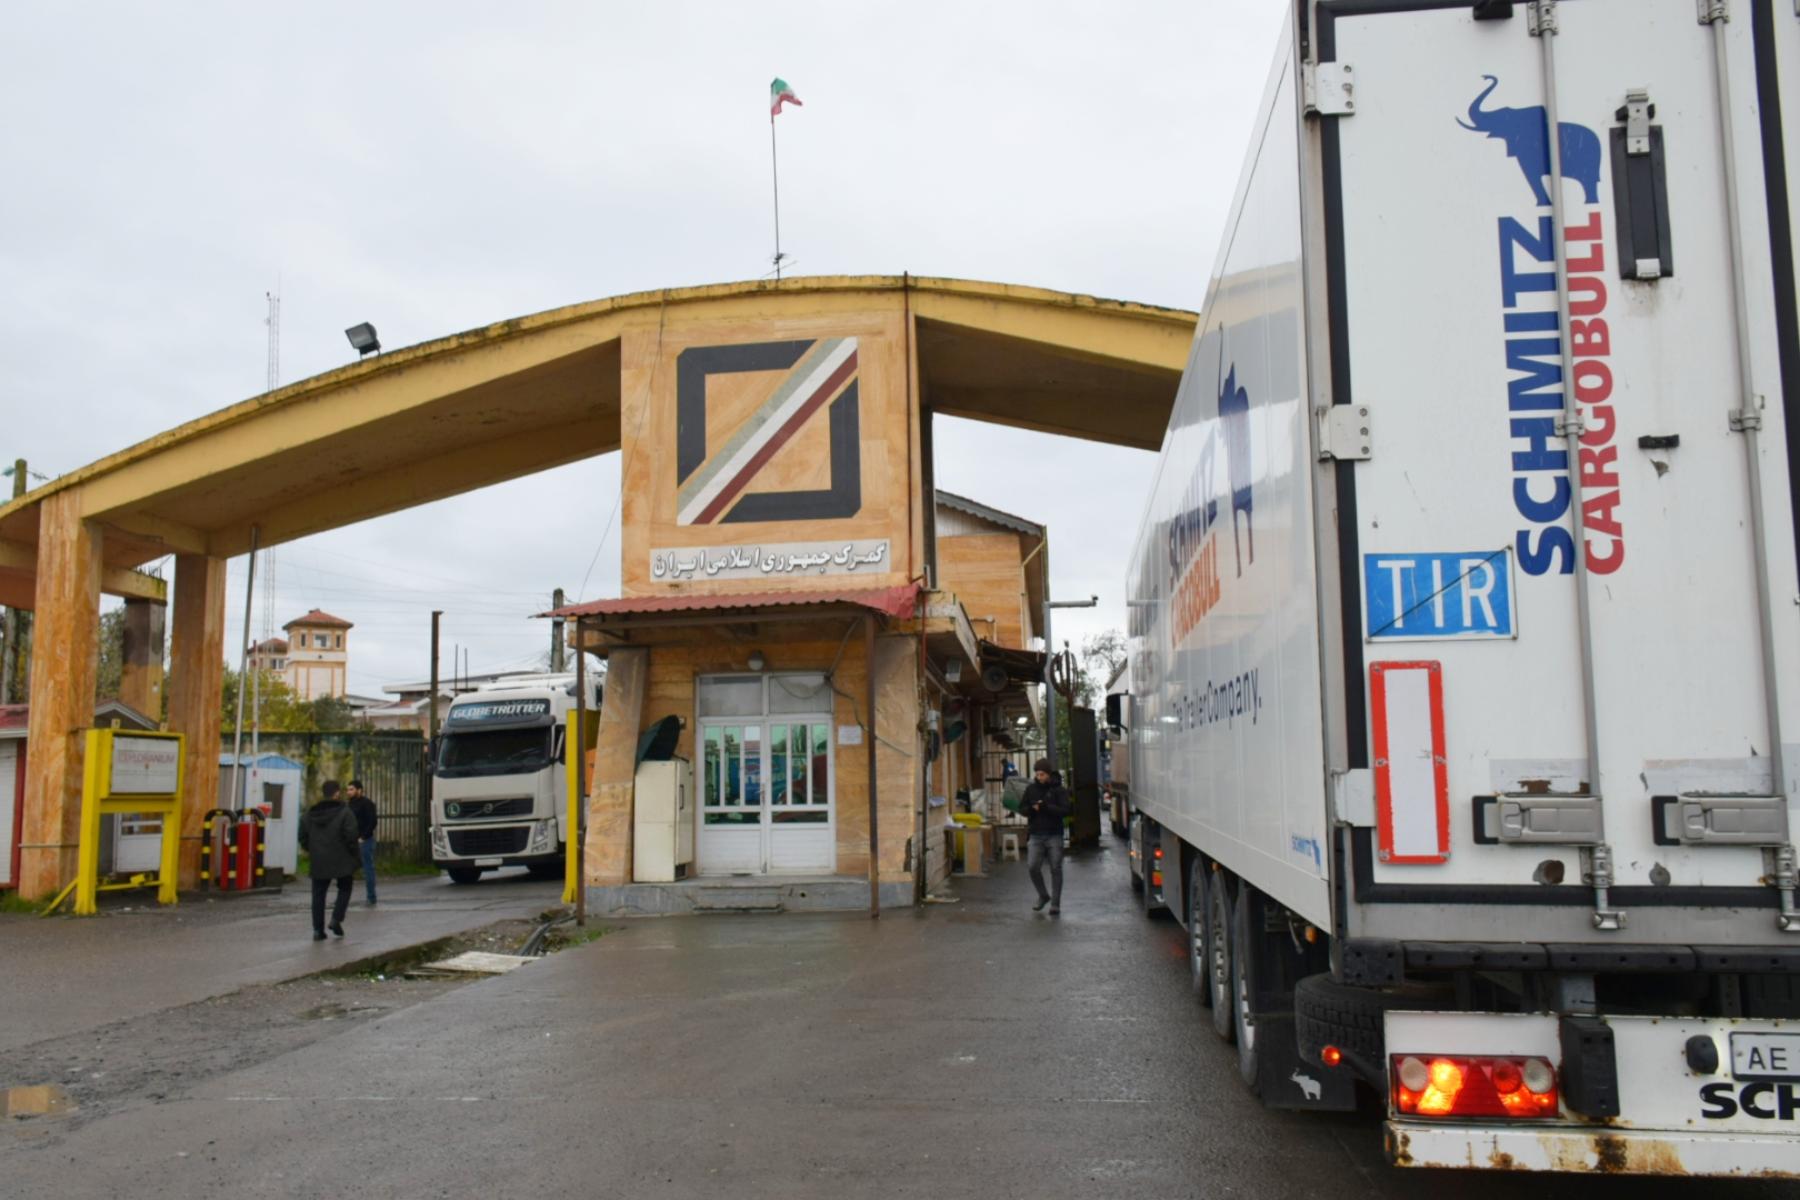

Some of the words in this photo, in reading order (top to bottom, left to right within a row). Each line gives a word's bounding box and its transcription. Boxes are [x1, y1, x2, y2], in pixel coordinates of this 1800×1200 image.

[1498, 216, 1576, 577] SCHMITZ
[1564, 211, 1626, 576] CARGOBULL
[653, 549, 706, 579] ایران
[705, 546, 760, 576] اسلامی
[760, 550, 832, 575] جمهوری
[1377, 558, 1498, 629] TIR
[452, 703, 546, 719] GLOBETROTTER
[1206, 667, 1263, 731] Company.
[1748, 1046, 1788, 1071] AE
